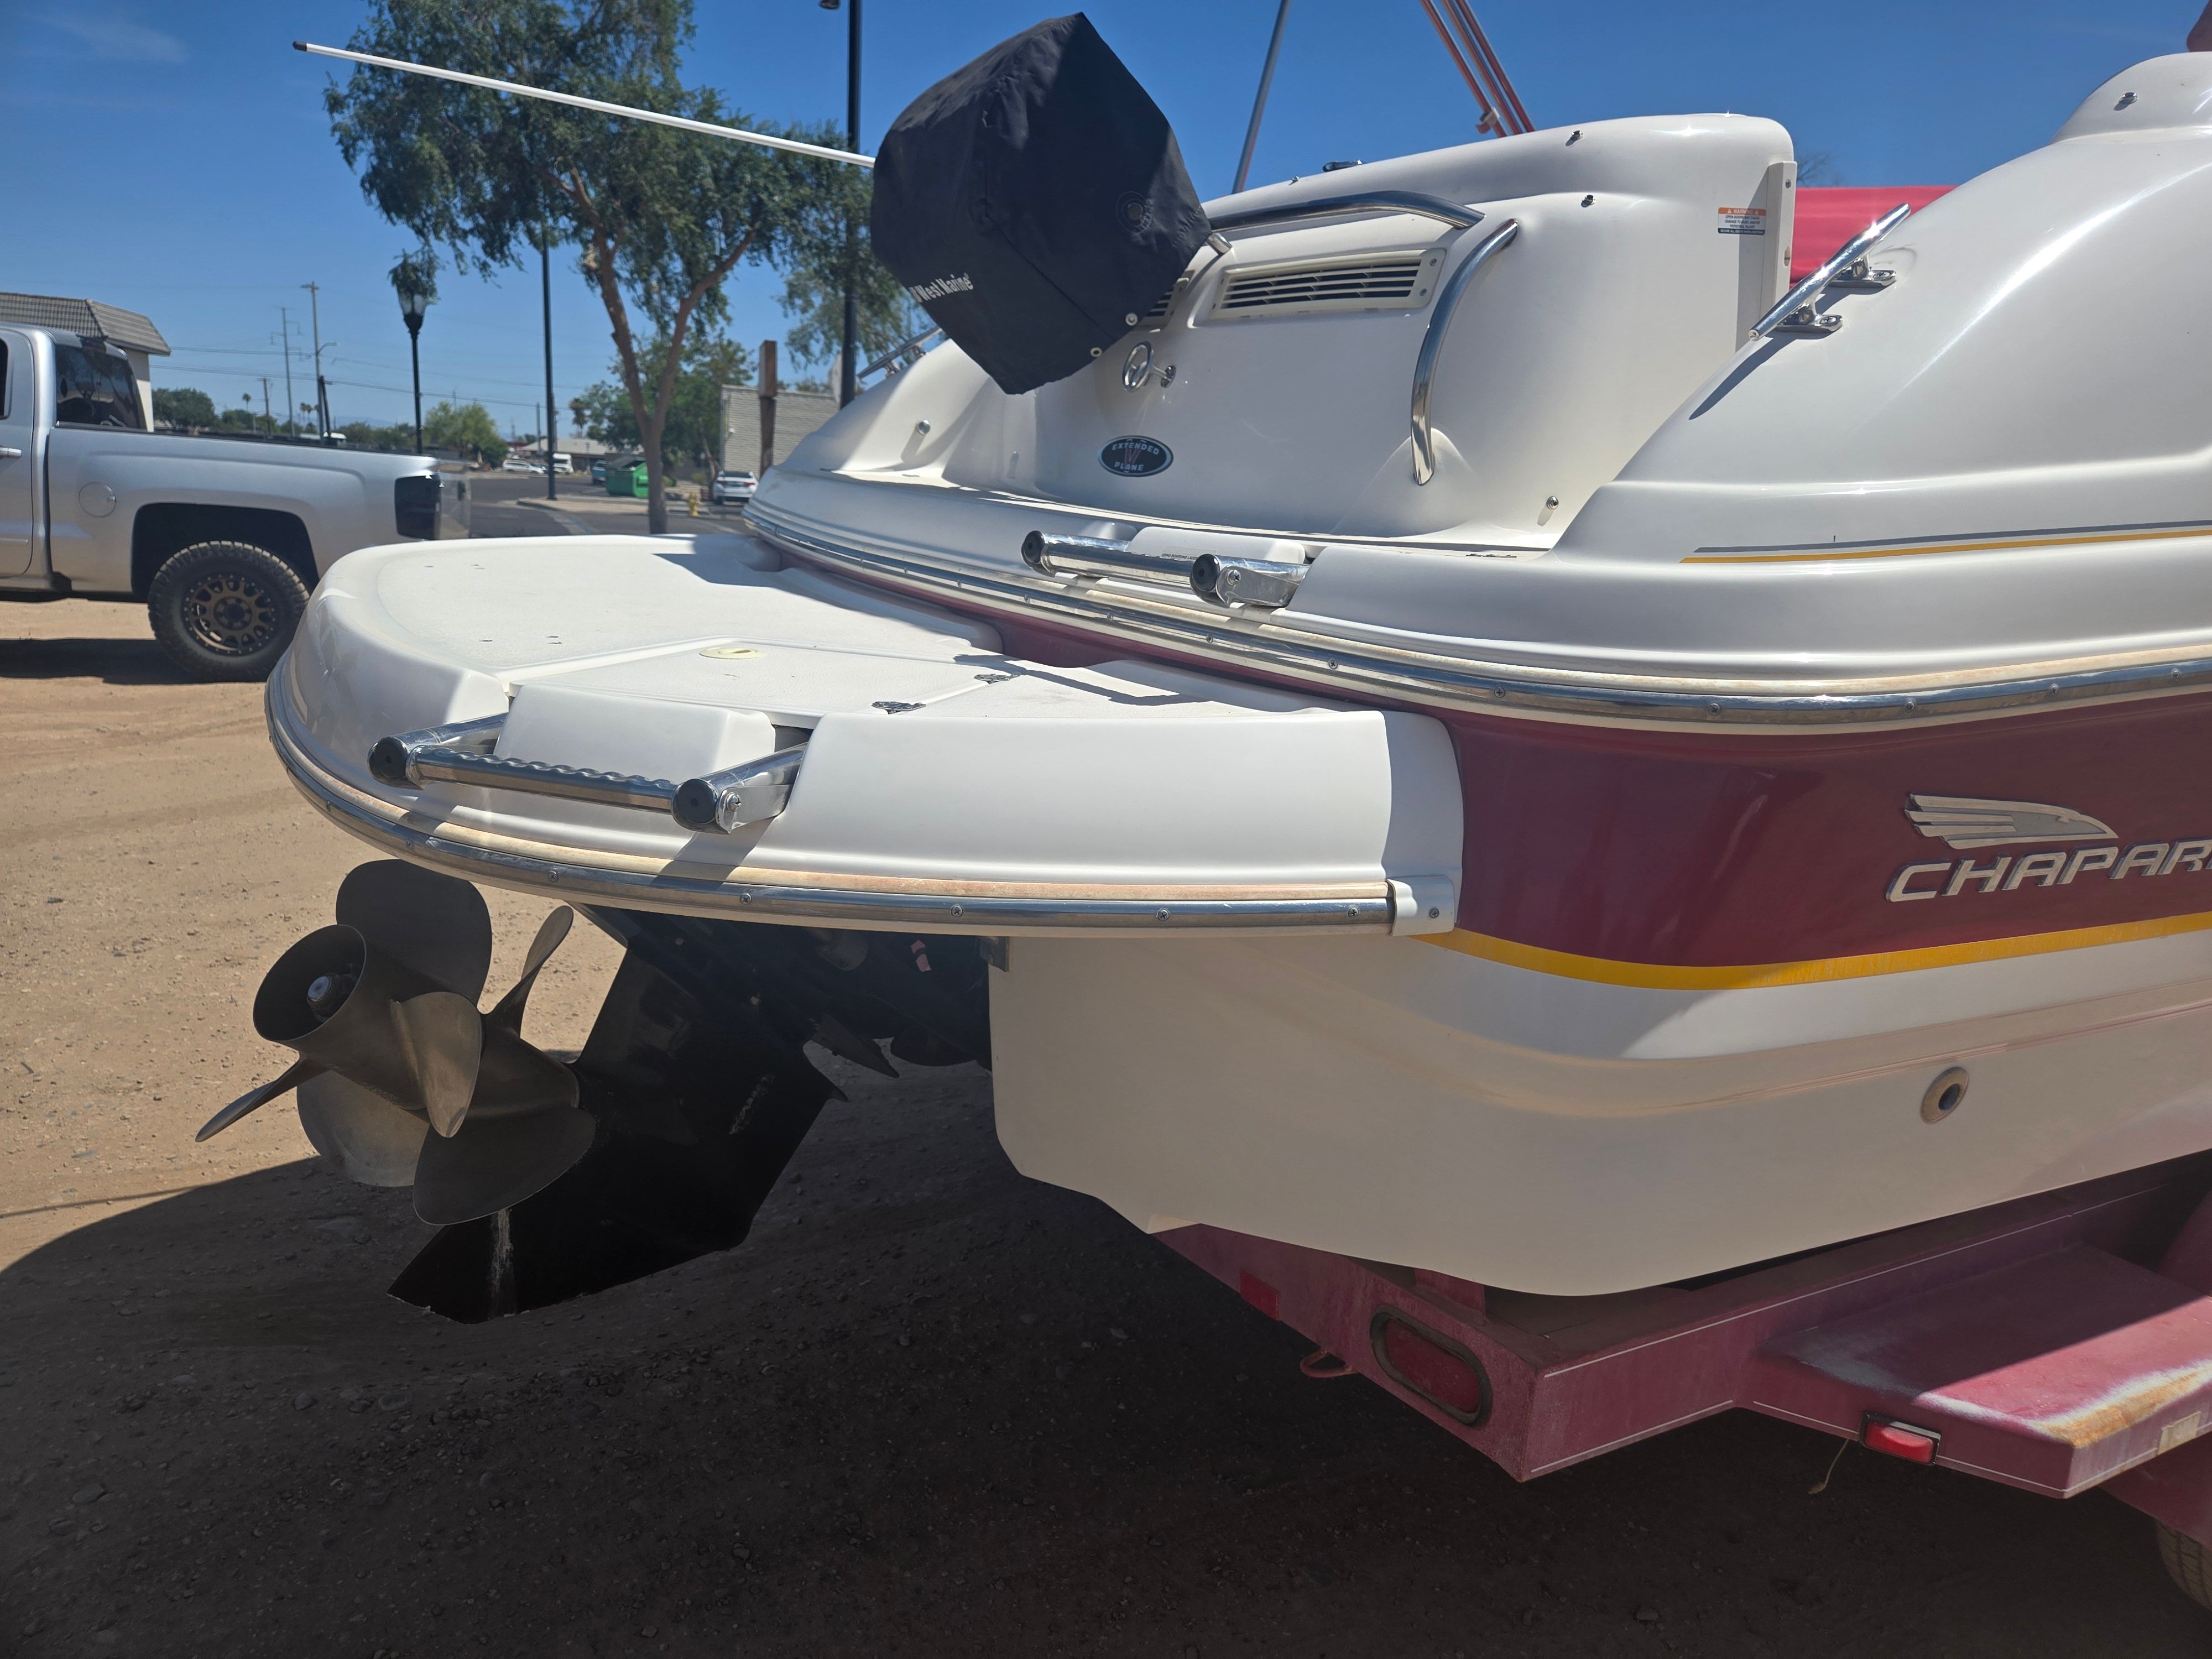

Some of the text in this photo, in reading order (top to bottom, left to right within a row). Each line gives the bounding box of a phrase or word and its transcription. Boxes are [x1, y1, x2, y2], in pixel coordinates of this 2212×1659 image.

[914, 281, 945, 301] West
[1112, 442, 1160, 455] EXTENDED
[1114, 461, 1144, 471] PLANE
[1885, 839, 2212, 902] CHAPAR
